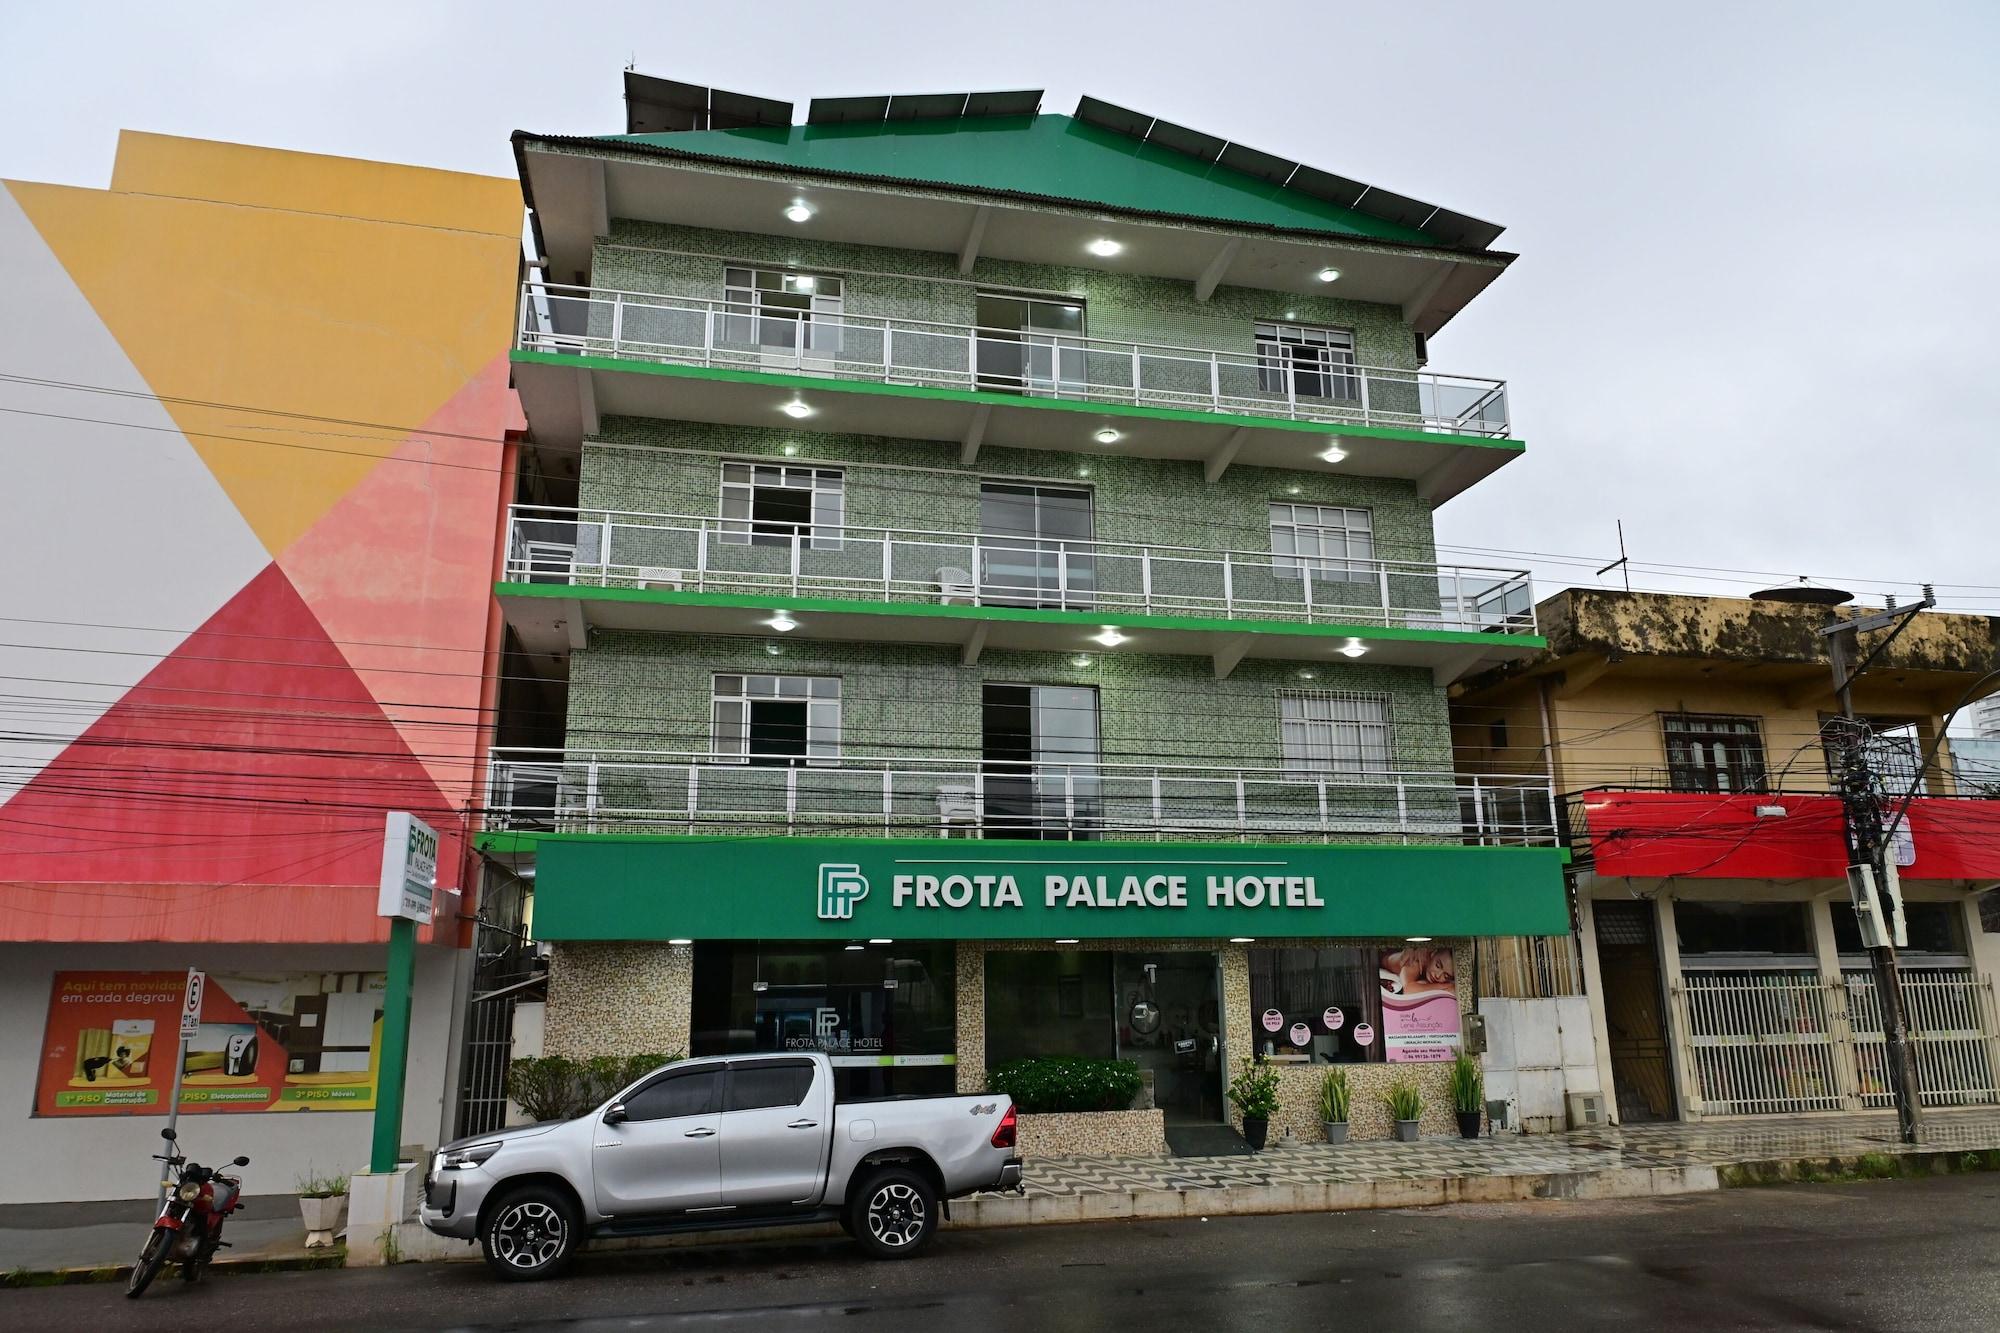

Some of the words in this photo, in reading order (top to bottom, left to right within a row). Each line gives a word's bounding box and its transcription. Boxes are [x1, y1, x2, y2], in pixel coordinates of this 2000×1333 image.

[416, 830, 436, 862] FROTA
[892, 875, 1023, 908] FROTA
[1045, 875, 1188, 908] PALACE
[1206, 876, 1325, 908] HOTEL
[63, 980, 96, 993] Aqui
[100, 981, 127, 991] tem
[130, 980, 187, 991] novidad
[61, 994, 83, 1003] em
[86, 993, 122, 1003] cada
[125, 992, 175, 1004] degrau
[190, 982, 198, 1005] E
[785, 1037, 815, 1048] FROTA
[817, 1037, 851, 1048] PALACE
[854, 1037, 883, 1048] HOTEL
[75, 1094, 101, 1103] PISO
[184, 1093, 208, 1101] PISO
[210, 1092, 268, 1100] Eletrodomésticos
[306, 1090, 329, 1098] PISO
[331, 1089, 356, 1097] Móveis
